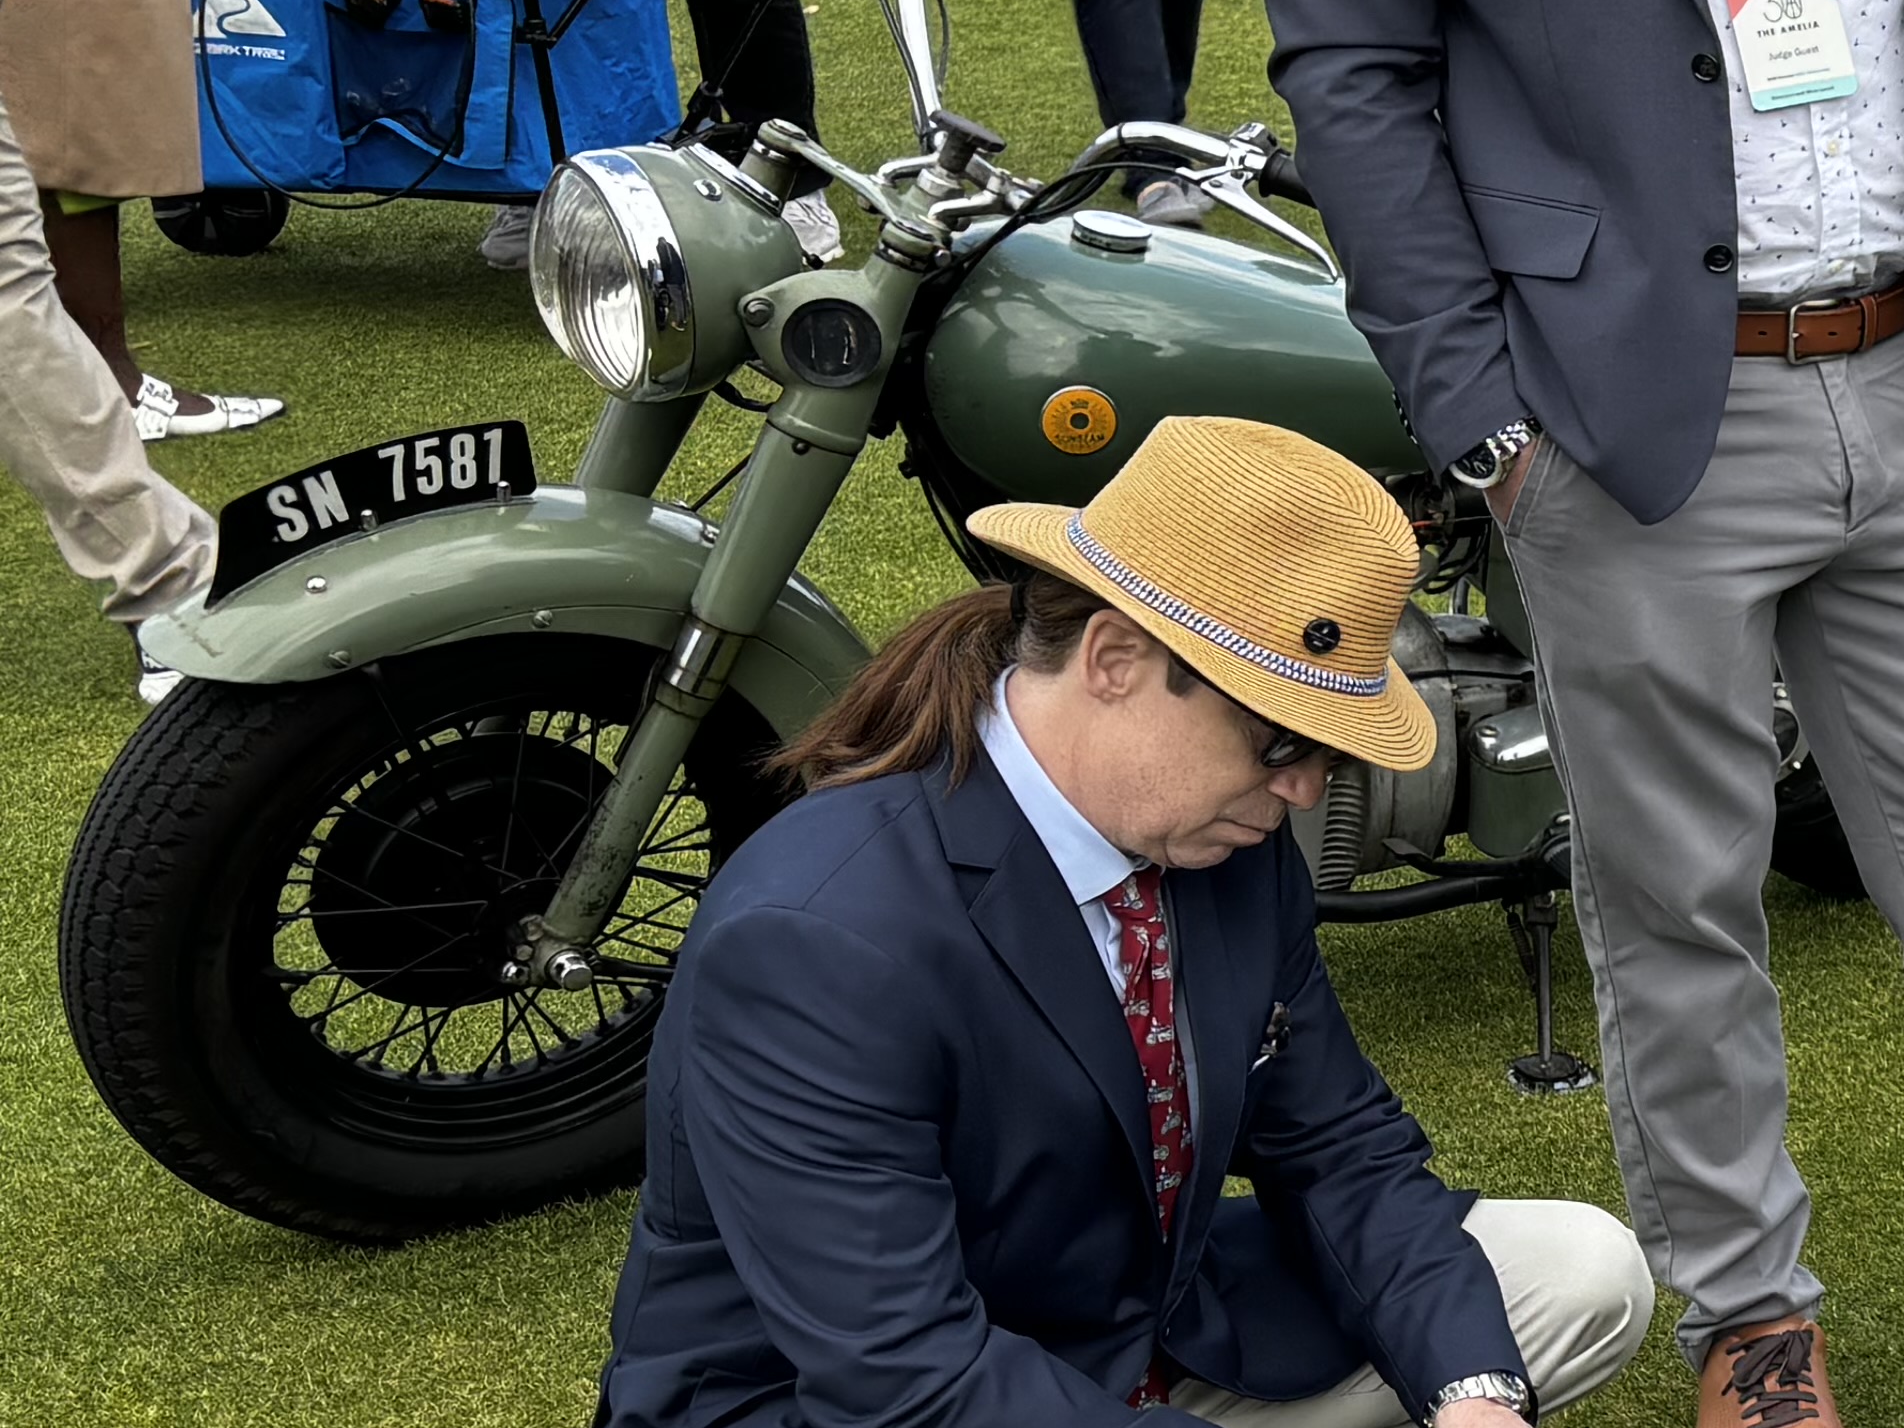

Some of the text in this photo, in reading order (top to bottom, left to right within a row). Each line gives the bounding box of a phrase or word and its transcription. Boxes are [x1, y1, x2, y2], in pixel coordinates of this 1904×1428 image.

[1757, 21, 1820, 38] THE AMELIA
[266, 427, 504, 543] SN 7581
